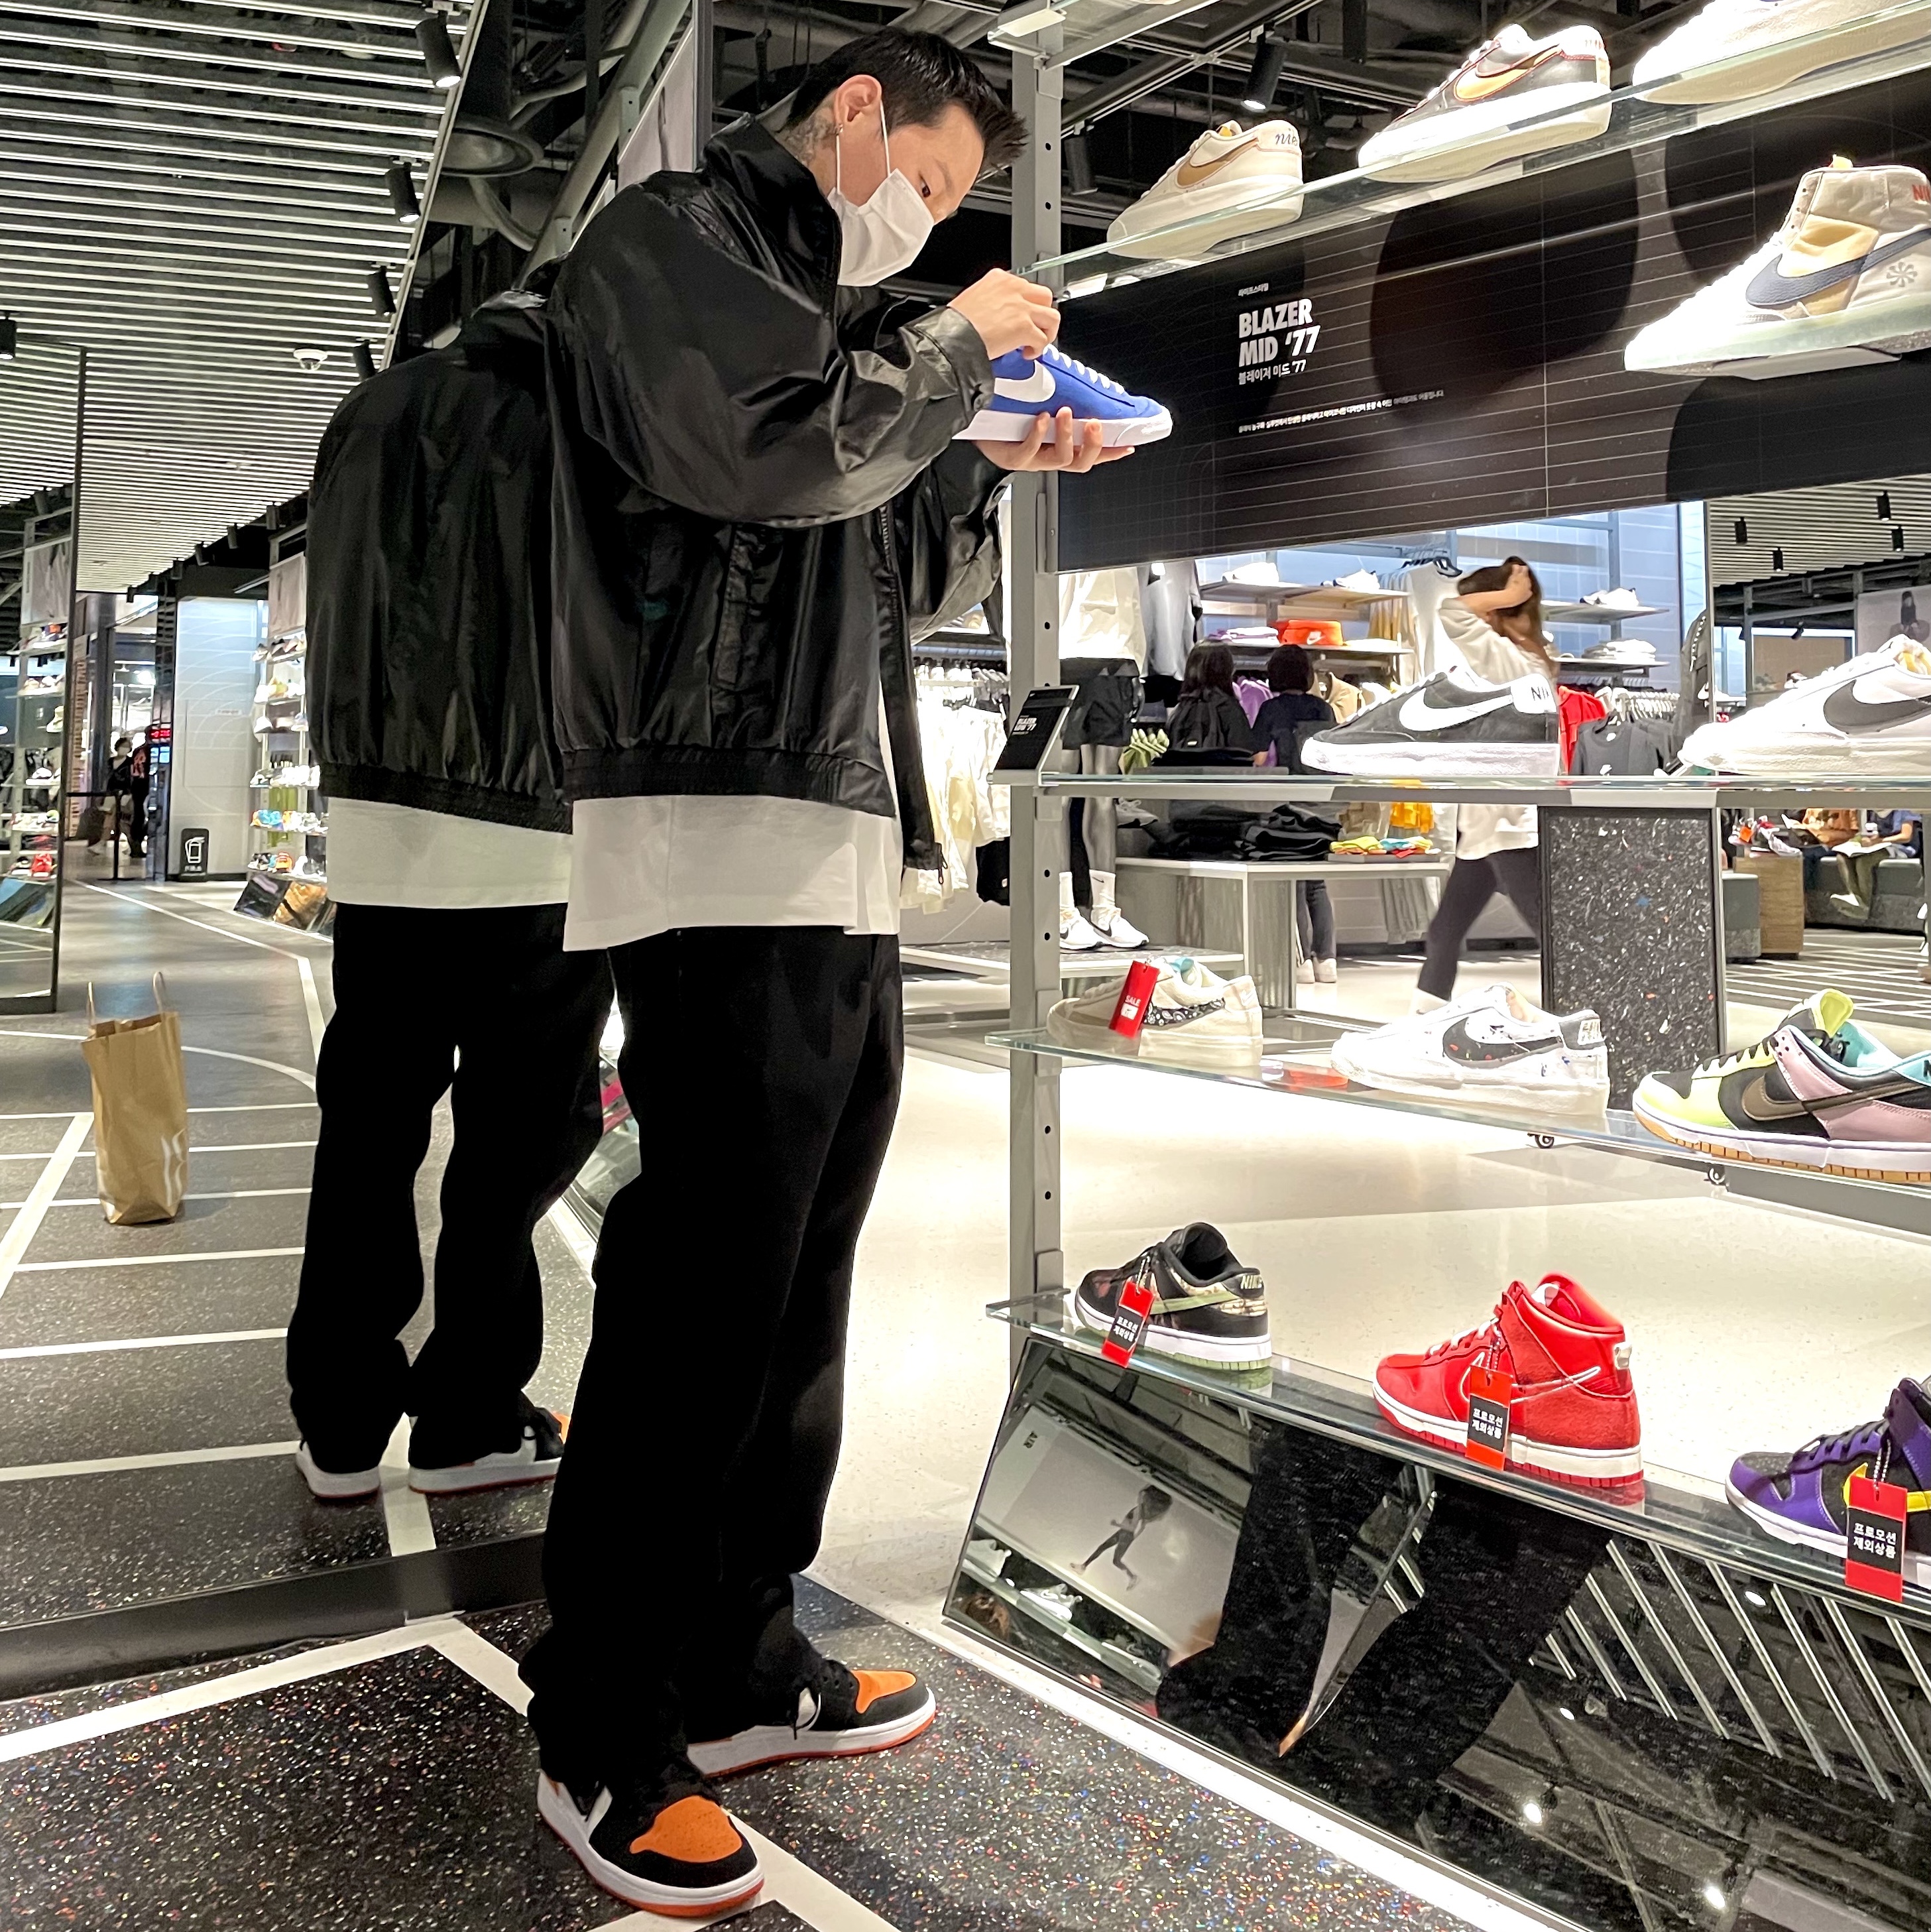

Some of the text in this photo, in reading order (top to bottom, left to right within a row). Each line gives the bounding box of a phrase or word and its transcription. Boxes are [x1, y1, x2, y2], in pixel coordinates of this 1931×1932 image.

[1239, 298, 1313, 339] BLAZER
[1239, 325, 1321, 367] MID '77
[1273, 363, 1291, 377] 미드
[1125, 995, 1141, 1007] SALE
[1473, 1408, 1503, 1428] 프로모션
[1472, 1419, 1501, 1439] 제외상품
[1854, 1523, 1896, 1545] 프로모션
[1853, 1536, 1896, 1559] 제외상품
